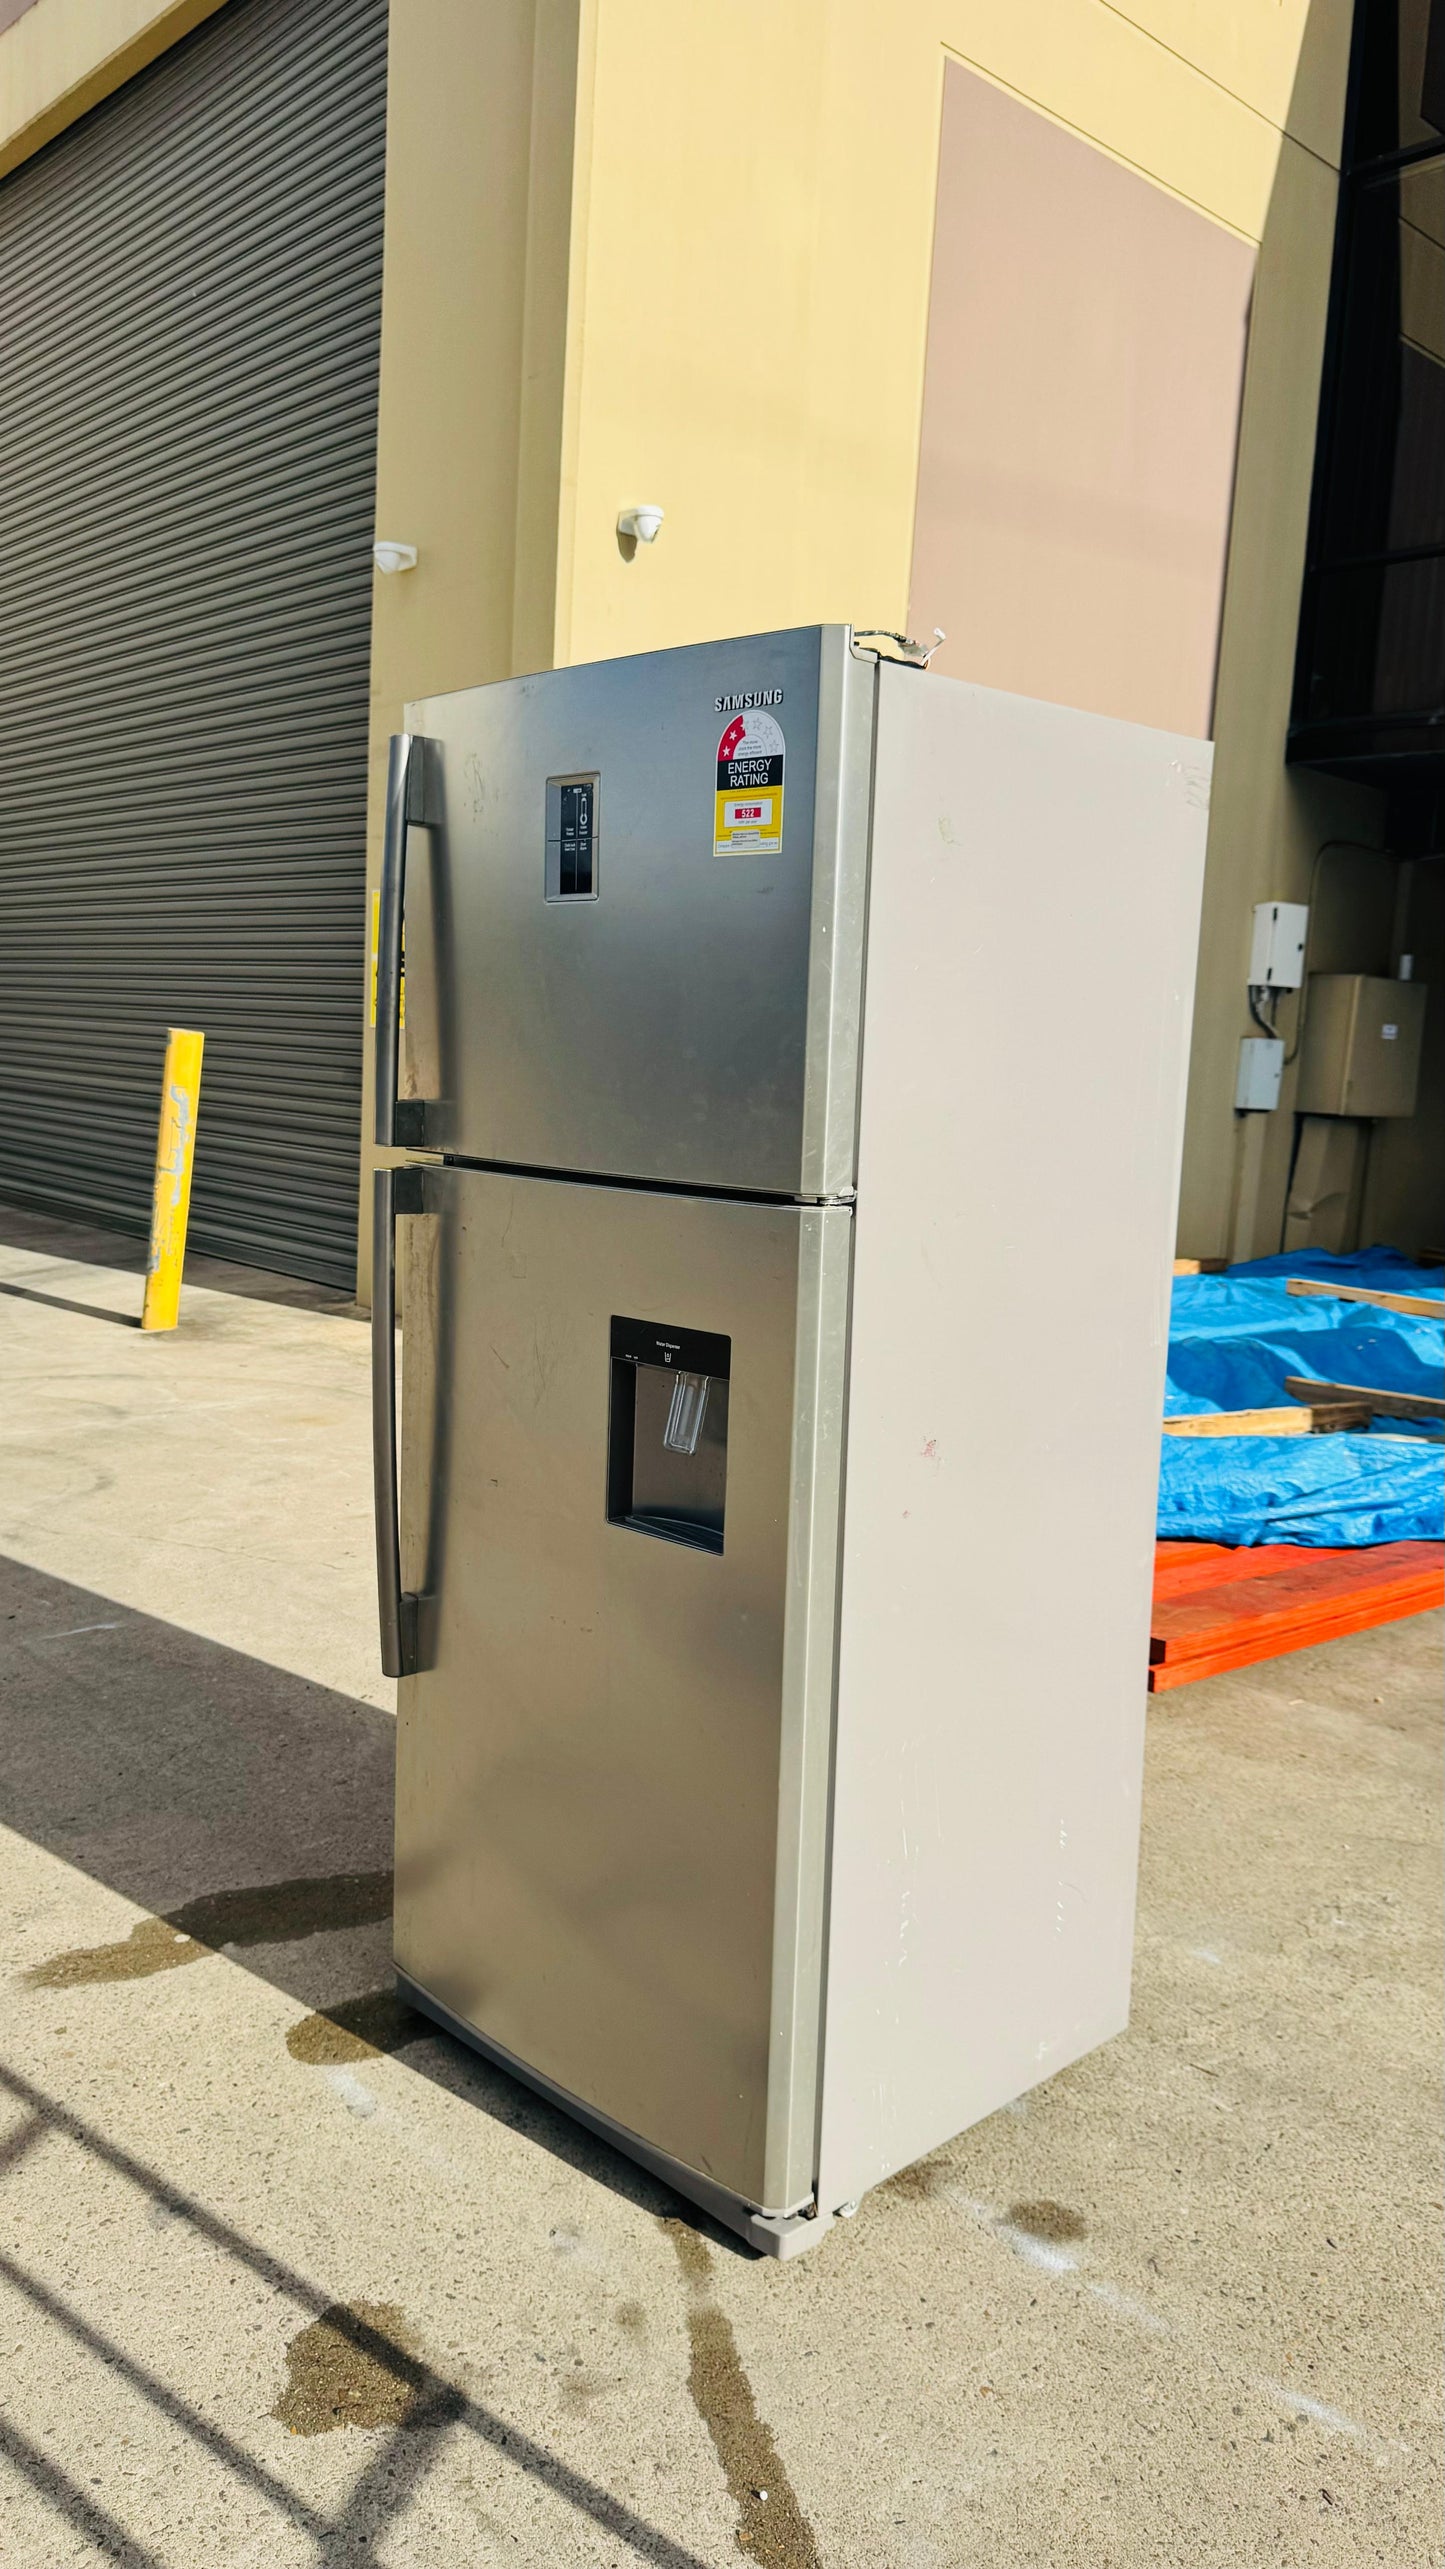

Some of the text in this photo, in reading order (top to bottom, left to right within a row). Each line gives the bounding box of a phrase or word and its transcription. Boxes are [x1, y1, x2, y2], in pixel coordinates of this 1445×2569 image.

[714, 688, 783, 712] SAMSUNG
[728, 758, 772, 774] ENERGY
[730, 772, 769, 787] RATING
[741, 809, 754, 818] 522
